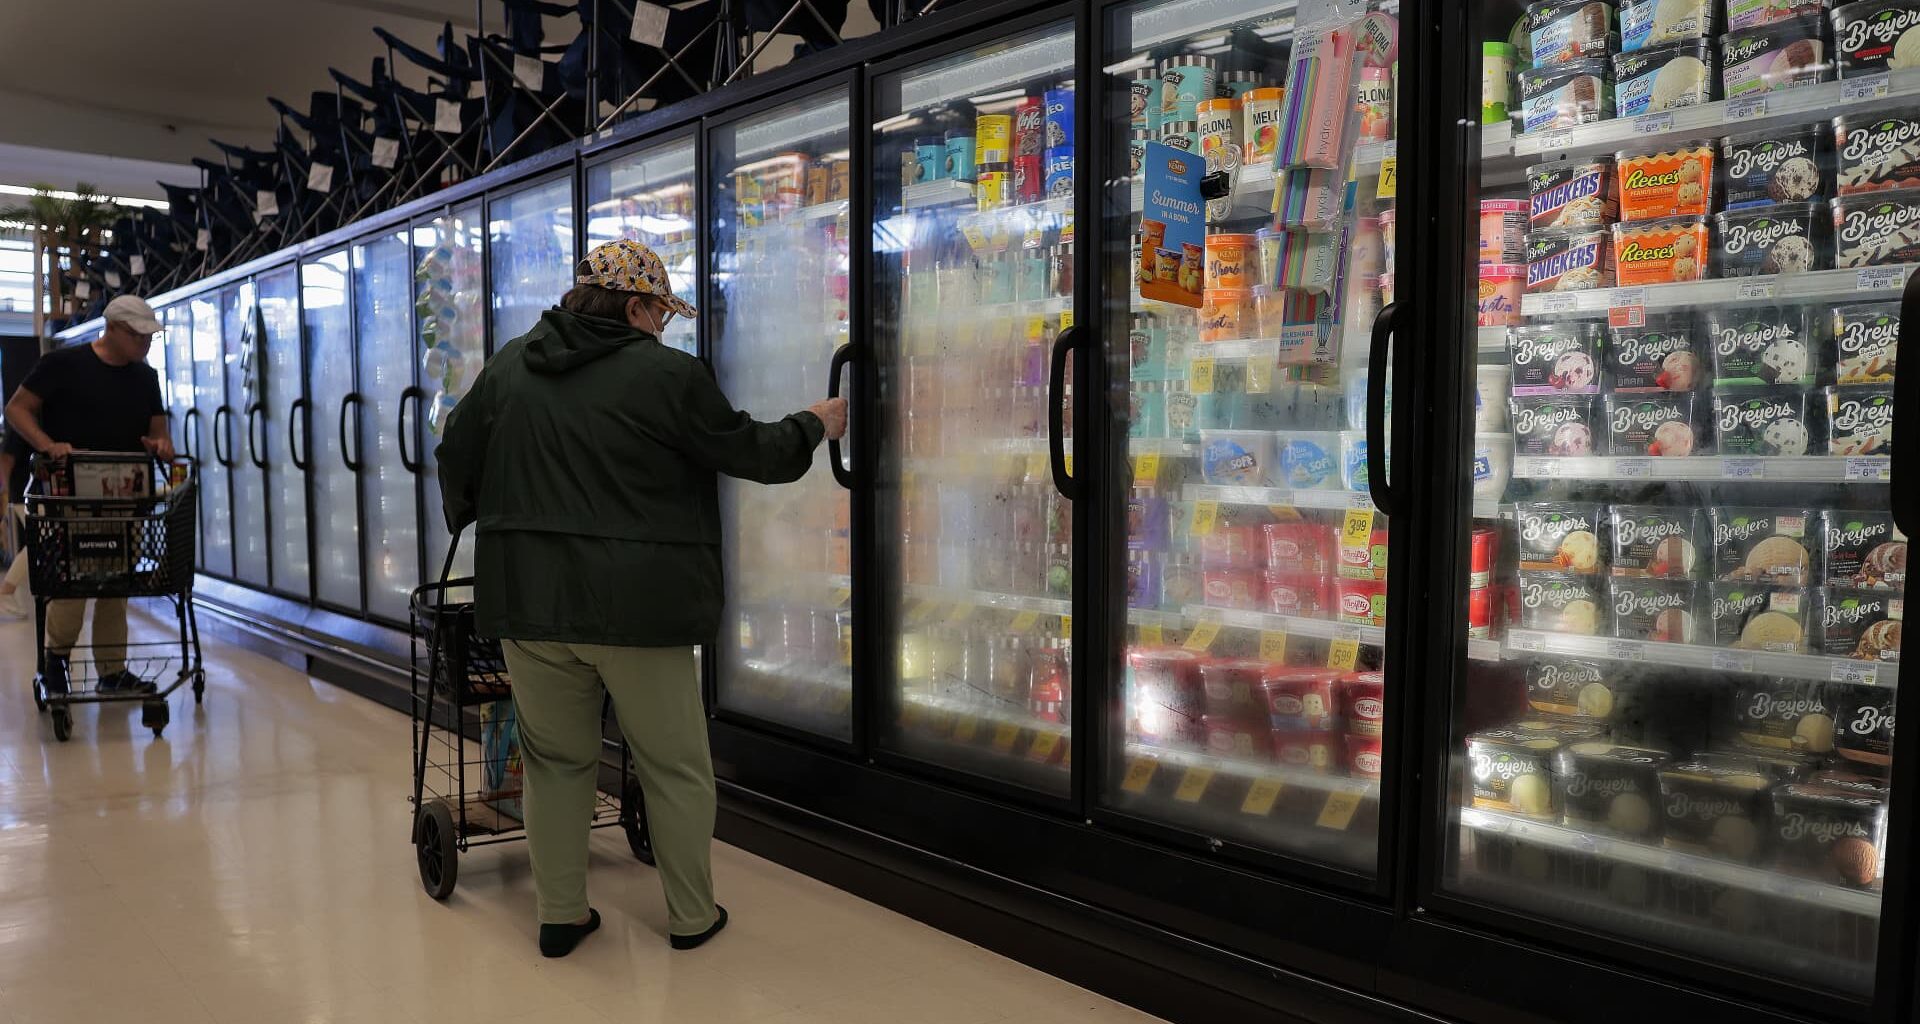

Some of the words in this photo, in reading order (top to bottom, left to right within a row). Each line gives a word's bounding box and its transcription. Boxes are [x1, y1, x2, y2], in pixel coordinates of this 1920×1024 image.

[1531, 7, 1560, 28] Breyers
[1364, 18, 1390, 52] MELONA
[1723, 37, 1769, 66] Breyers
[1617, 59, 1648, 80] Breyers
[1358, 88, 1393, 104] ELONA
[1253, 109, 1281, 126] MELO
[1843, 122, 1920, 161] Breyer
[1730, 140, 1807, 179] Breyers
[1532, 172, 1600, 216] SNICKERS
[1624, 169, 1680, 191] Reese's
[1152, 189, 1200, 216] Summer
[1725, 219, 1804, 255] Breyers
[1218, 250, 1241, 258] KEMP
[1528, 243, 1597, 285] SNICKERS
[1620, 243, 1675, 263] Reese's
[1212, 260, 1241, 279] Sherb
[1619, 336, 1690, 365] Breyers
[1718, 323, 1795, 356] Breyers
[1841, 321, 1900, 352] Breye
[1515, 337, 1583, 365] Breyers
[1516, 407, 1583, 435] Breyers
[1612, 404, 1683, 433] Breyers
[1719, 402, 1796, 432] Breyers
[1836, 400, 1893, 430] Brey
[1348, 518, 1367, 536] 399
[1522, 515, 1591, 541] Breyers
[1618, 519, 1686, 546] Breyers
[1716, 517, 1769, 546] Breyers
[1829, 522, 1886, 551] Breyers
[1344, 549, 1368, 561] Thrifty
[1344, 600, 1368, 613] Thrifty
[1524, 584, 1591, 609] Breyers
[1615, 590, 1686, 616] Breyers
[1712, 591, 1764, 620] Breyers
[1821, 600, 1881, 628] Breyers
[1334, 650, 1352, 666] 599
[1538, 664, 1602, 689] Breyers
[1748, 692, 1826, 720] Breyers
[1474, 754, 1536, 780] Breyers
[1567, 772, 1639, 797] Breyers
[1666, 792, 1744, 820] Breyers
[1780, 812, 1868, 844] Breyers
